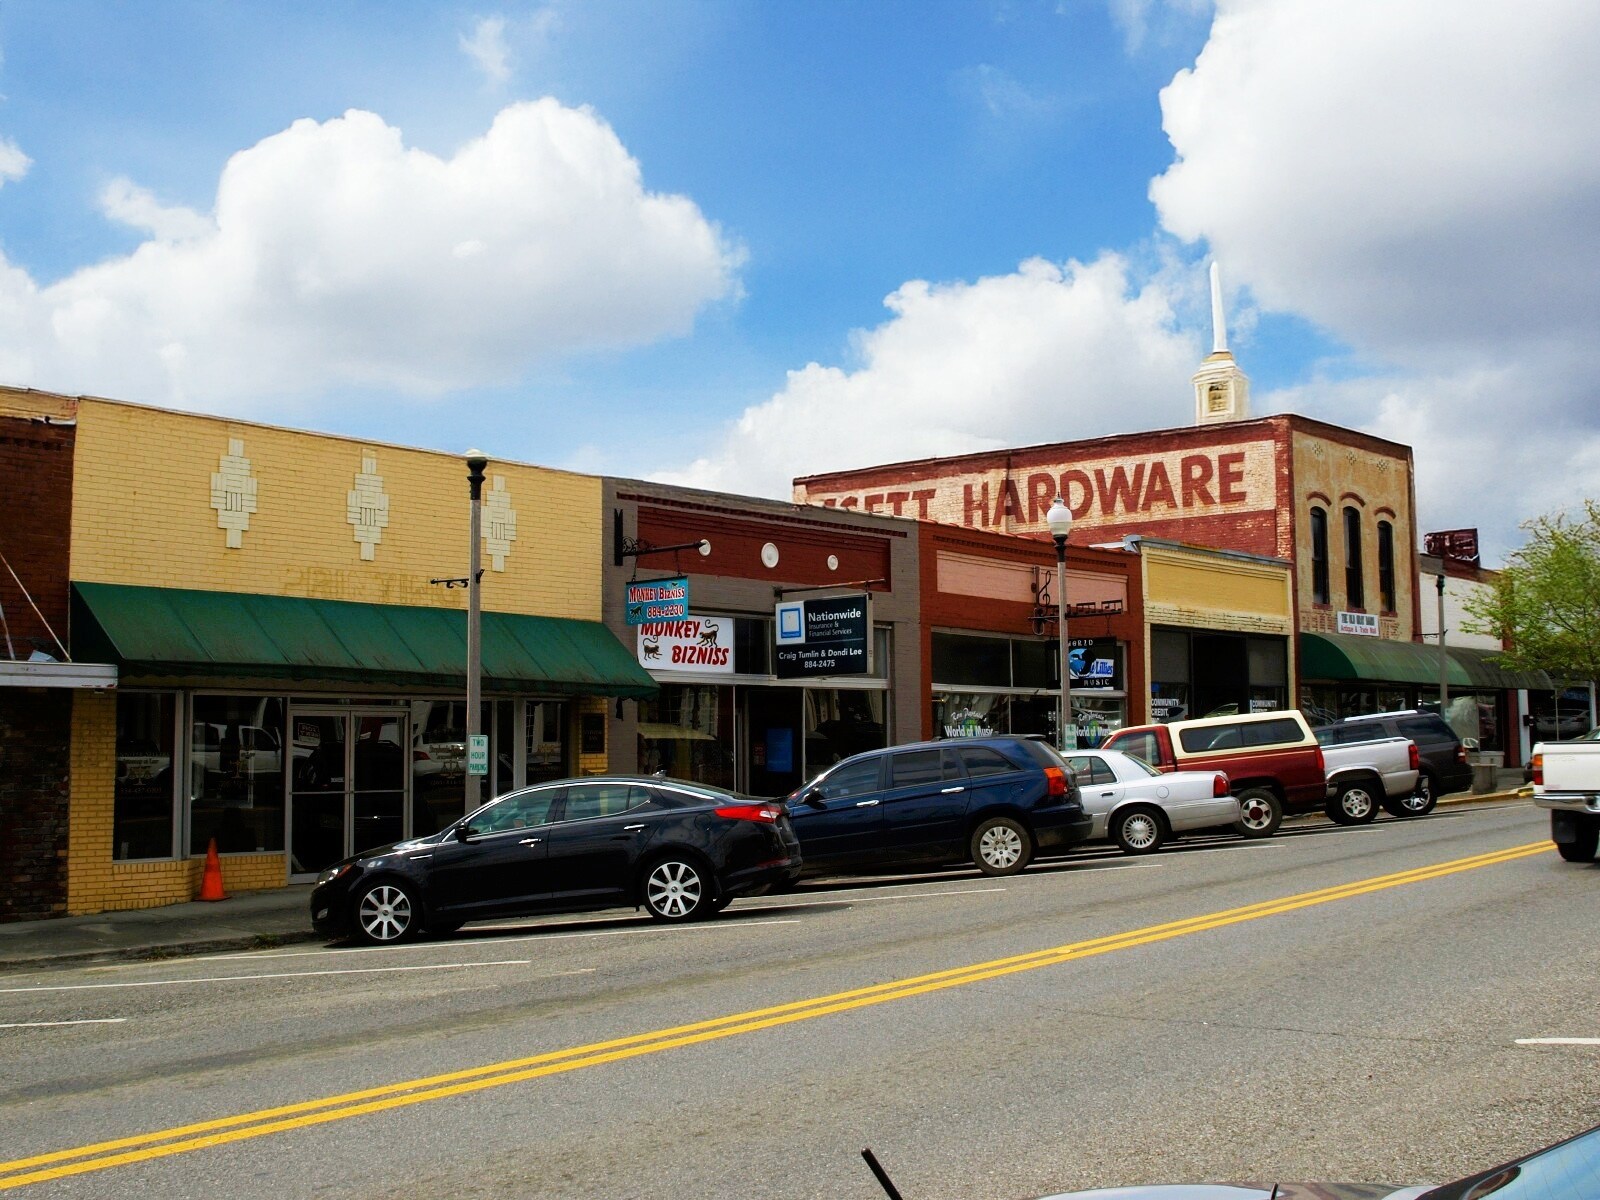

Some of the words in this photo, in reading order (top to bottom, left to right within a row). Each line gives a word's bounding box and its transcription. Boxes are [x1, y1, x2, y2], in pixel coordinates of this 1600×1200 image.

[963, 452, 1246, 527] HARDWARE
[647, 604, 684, 618] 884-2230
[808, 608, 861, 622] Nationwide
[641, 620, 701, 639] MONKEY
[809, 629, 831, 637] Financial
[832, 628, 852, 636] Services
[672, 645, 729, 666] BIZNISS
[779, 652, 797, 660] Craig
[798, 650, 819, 658] Tumlin
[828, 648, 848, 656] Dondi
[804, 660, 835, 668] 884-2475
[1083, 679, 1110, 687] MUSIC
[1252, 700, 1277, 708] COMMUNITY
[944, 725, 966, 737] World
[967, 725, 974, 737] of
[975, 725, 994, 737] Music
[473, 739, 485, 747] TWO
[471, 752, 486, 760] HOUR
[469, 764, 487, 772] PARKING
